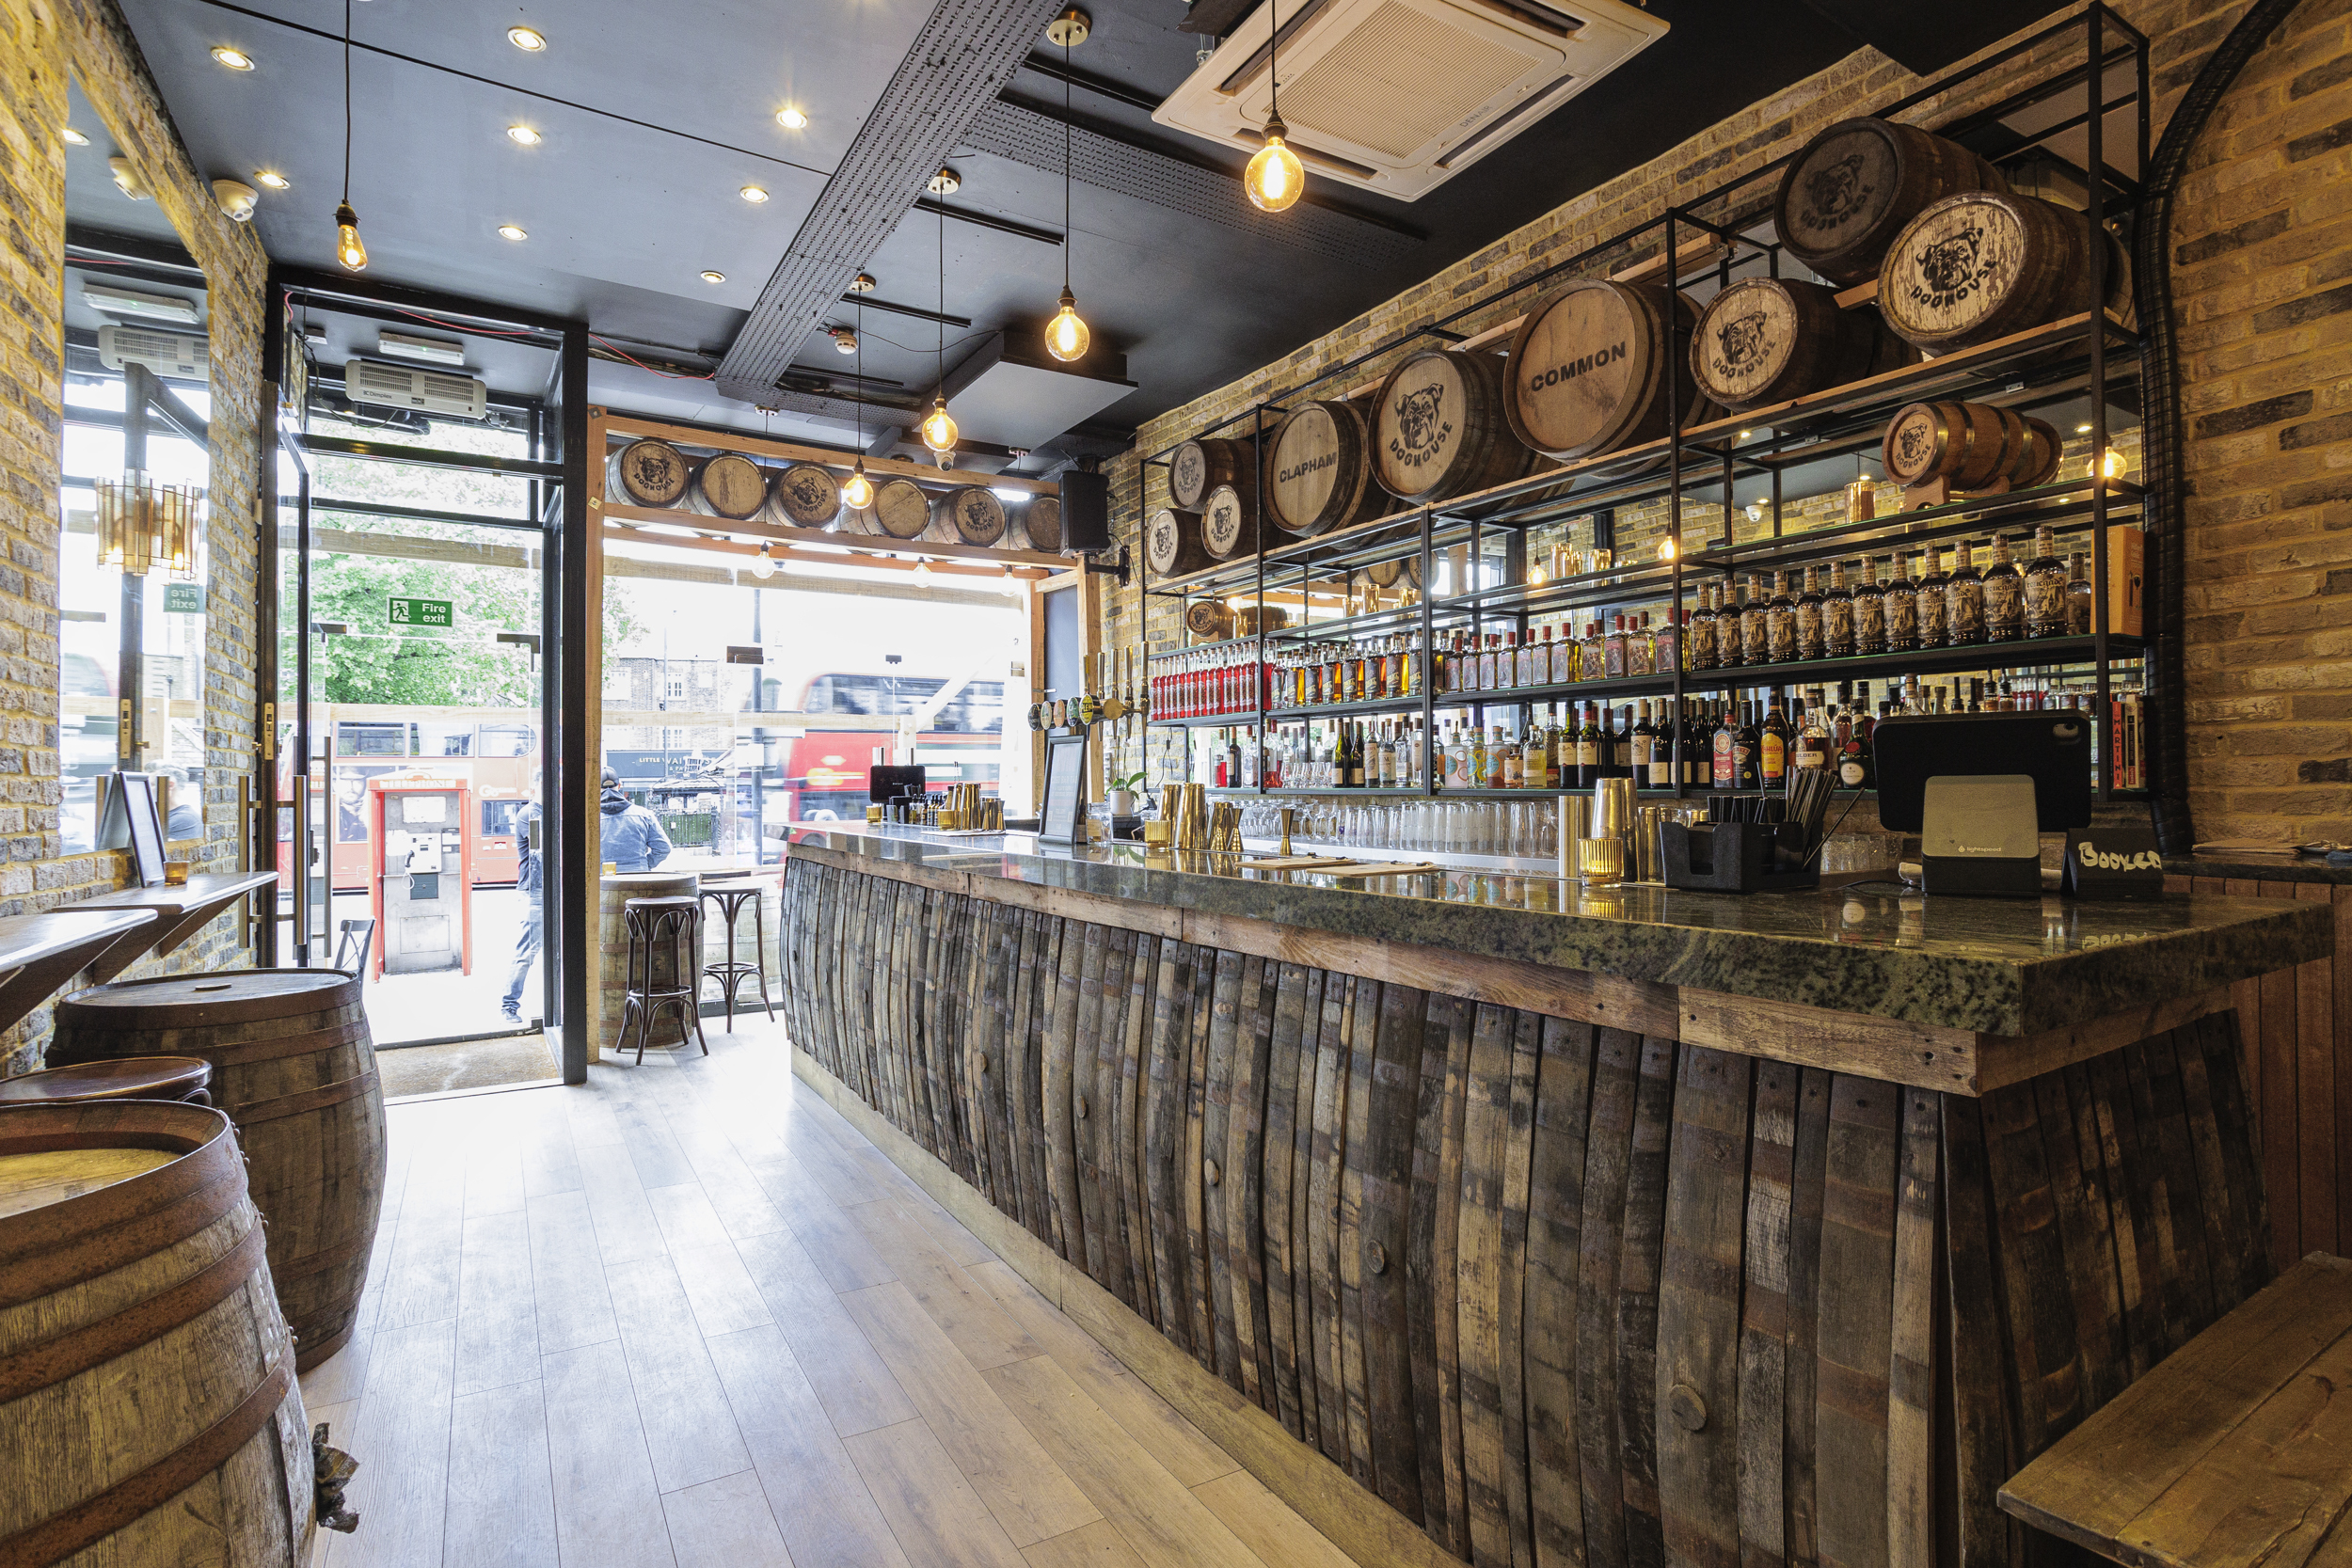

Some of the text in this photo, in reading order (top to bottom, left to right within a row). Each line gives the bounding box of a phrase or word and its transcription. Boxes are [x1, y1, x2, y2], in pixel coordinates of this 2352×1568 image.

[1799, 184, 1874, 231] DOGHOUSE
[1910, 259, 1997, 309] DOGHOUSE
[1531, 341, 1626, 392] COMMON
[1712, 340, 1776, 378] DOGHOUSE
[1390, 420, 1453, 467] DOGHOUSE
[1896, 443, 1931, 468] DOGHOUSE
[1279, 451, 1337, 483] CLAPHAM
[633, 473, 675, 492] DOGHOUSE
[1178, 472, 1200, 494] DOGHOUSE
[798, 488, 827, 512] DOGHOUSE
[964, 515, 995, 531] DOGHOUSE
[1210, 524, 1235, 544] DOGHOUSE
[1152, 541, 1173, 560] DOGHOUSE
[421, 602, 447, 613] Fire
[422, 614, 446, 624] exit
[2113, 719, 2122, 781] MARTINI
